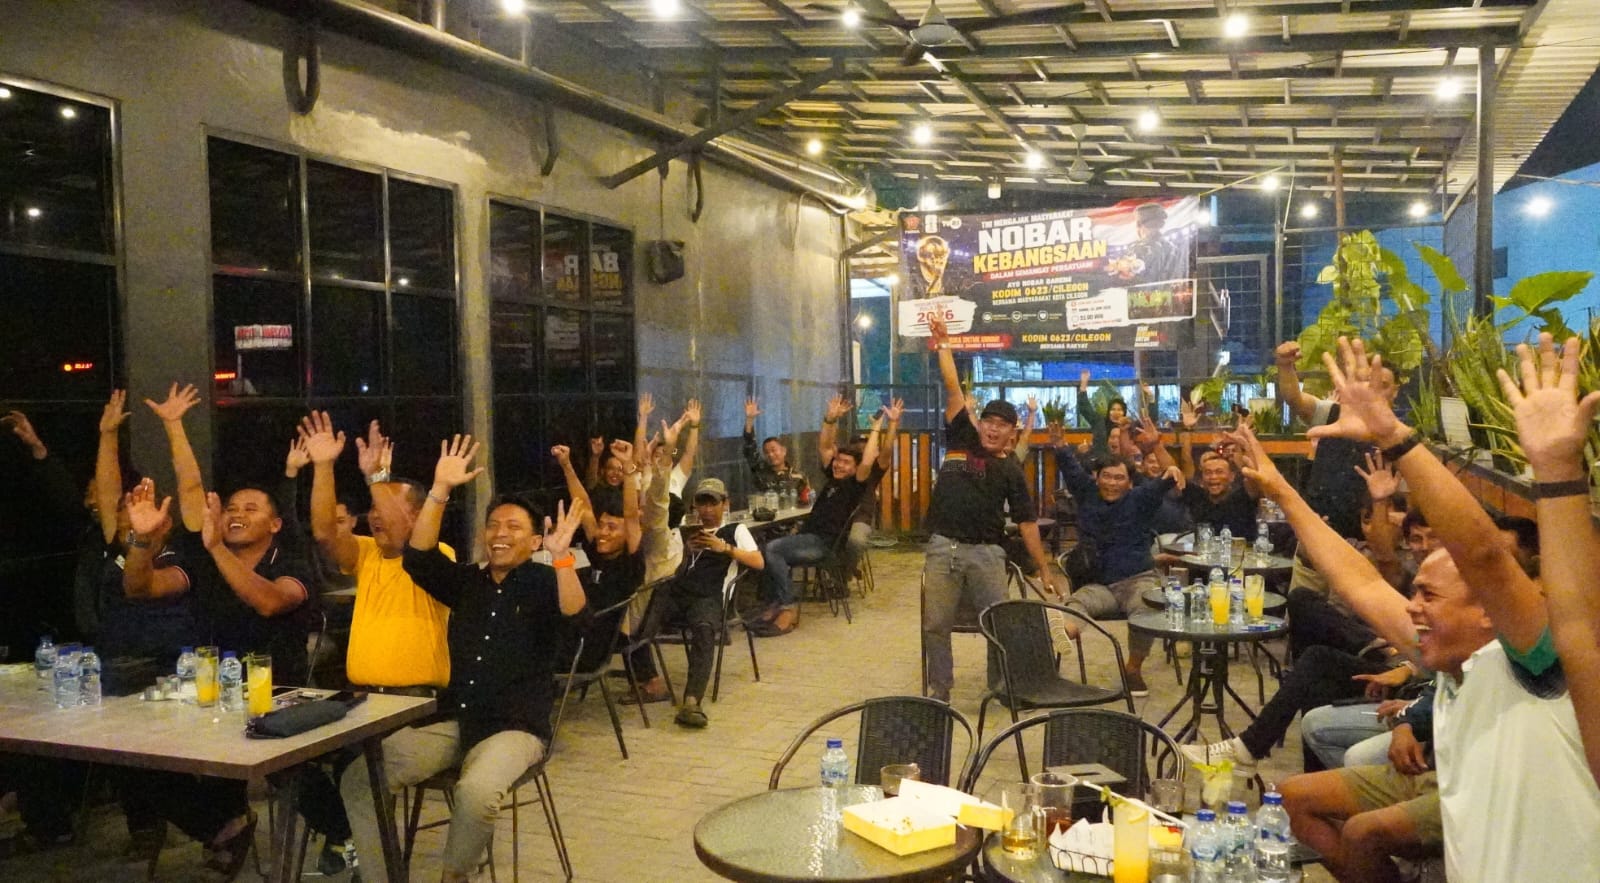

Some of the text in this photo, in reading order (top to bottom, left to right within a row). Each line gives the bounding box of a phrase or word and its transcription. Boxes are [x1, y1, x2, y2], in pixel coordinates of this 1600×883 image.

[978, 216, 1092, 254] NOBAR
[973, 240, 1107, 274] KEBANGSAAN
[990, 261, 1094, 280] DALAM SEMANGAT PERSATUAN
[992, 282, 1089, 299] KODIM 0623/CILEGON
[1022, 279, 1044, 287] NOBAR
[1022, 332, 1112, 343] KODIM 0623/CILEGON
